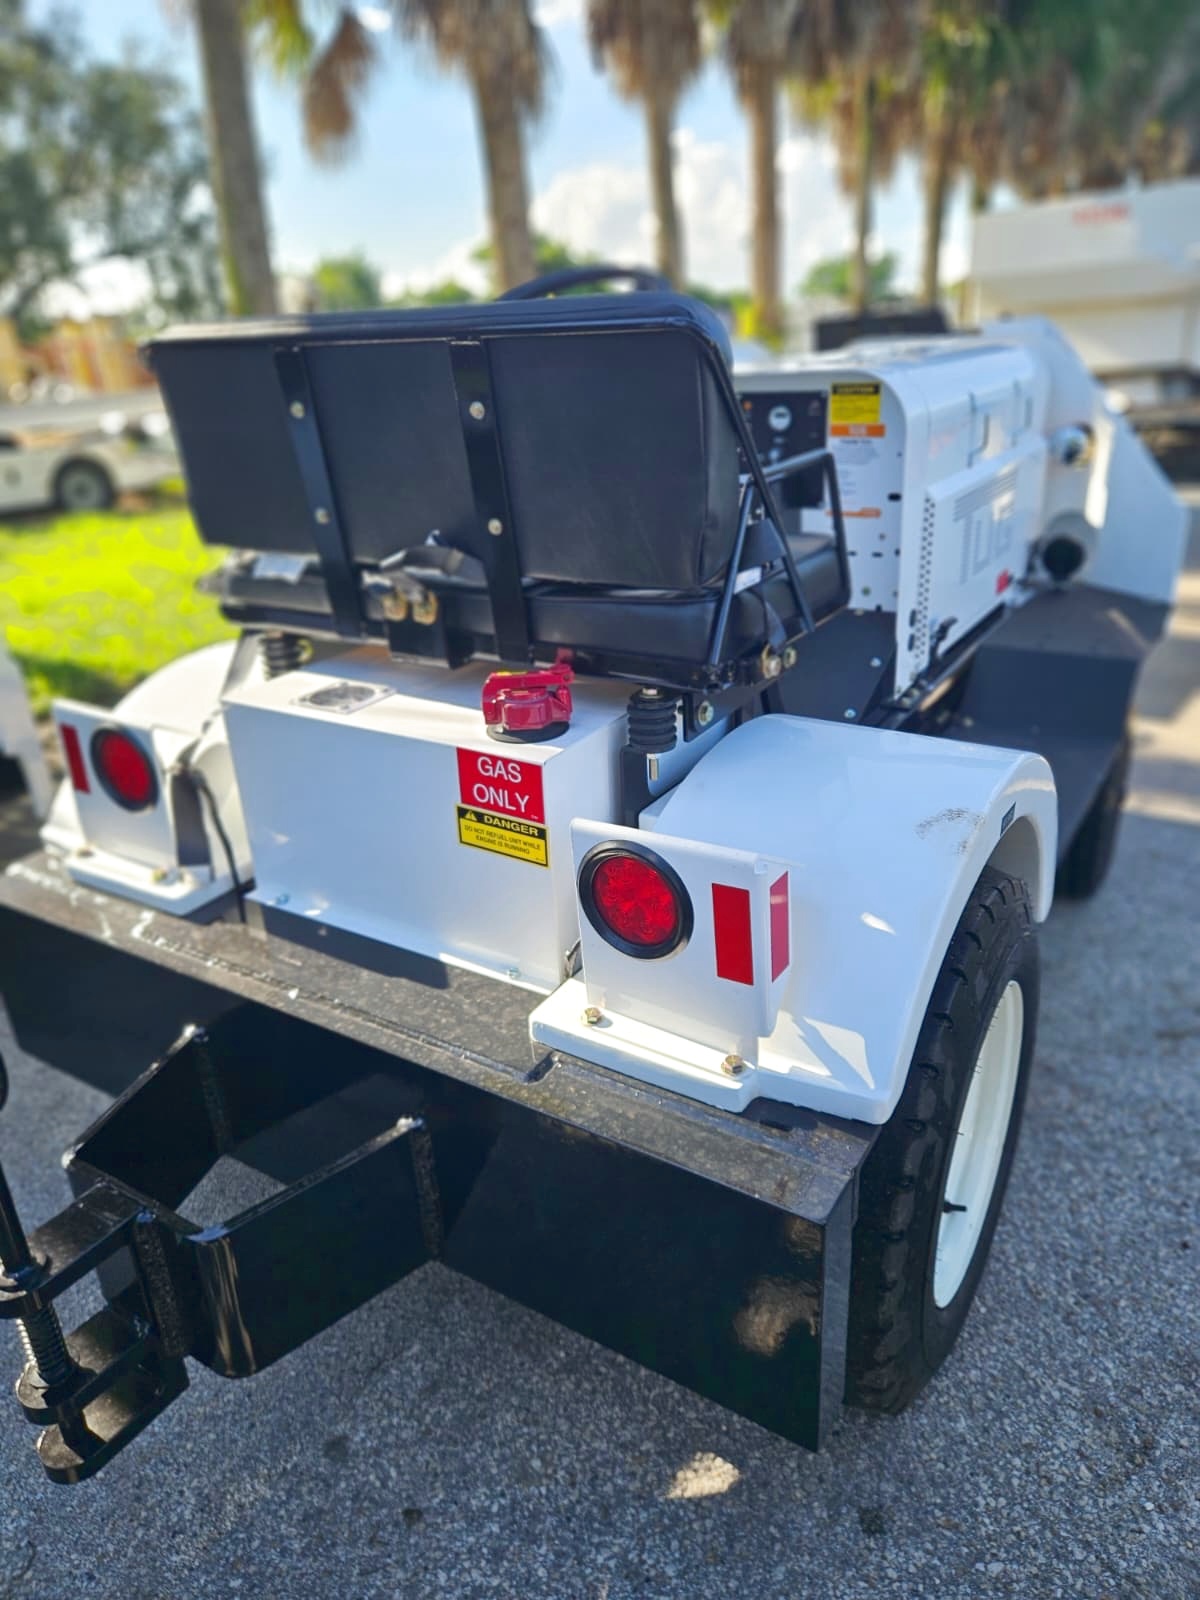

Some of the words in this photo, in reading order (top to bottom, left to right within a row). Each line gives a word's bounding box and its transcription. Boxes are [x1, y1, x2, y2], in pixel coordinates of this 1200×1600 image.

[477, 756, 522, 783] GAS
[473, 783, 530, 813] ONLY
[484, 815, 538, 836] DANGER
[474, 827, 485, 835] NOT
[486, 830, 508, 841] REFUEL
[509, 836, 522, 845] UNIT
[522, 840, 540, 850] WHILE
[476, 835, 497, 845] ENGINE
[504, 842, 530, 854] RUNNING
